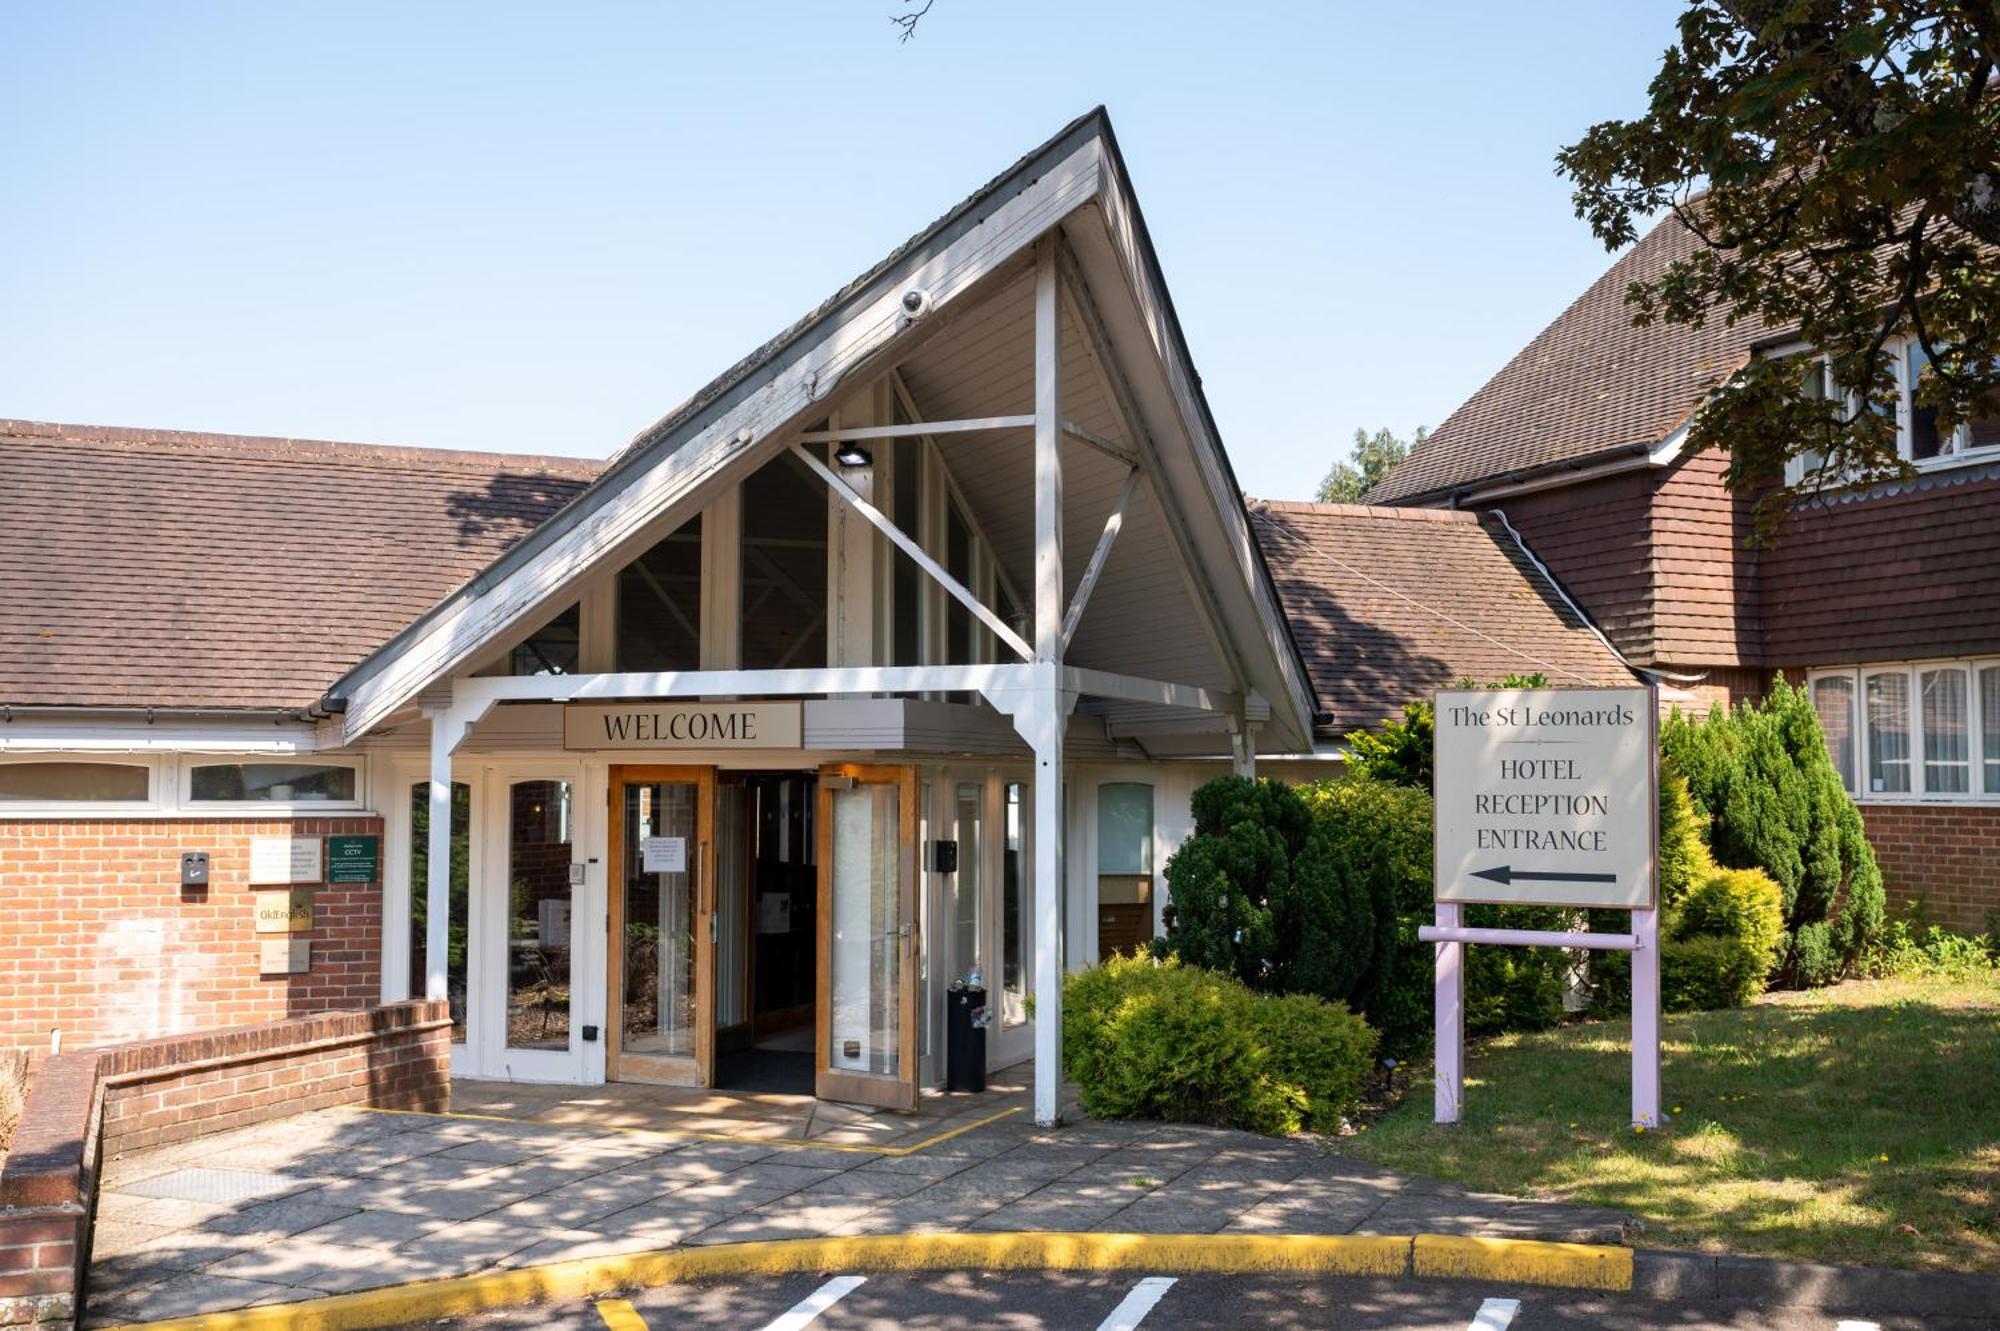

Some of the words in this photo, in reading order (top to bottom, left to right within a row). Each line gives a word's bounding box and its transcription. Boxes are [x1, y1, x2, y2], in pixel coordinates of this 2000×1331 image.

[603, 712, 757, 741] WELCOME
[1448, 705, 1491, 727] The
[1496, 706, 1518, 727] St
[1525, 704, 1634, 727] Leonards
[1500, 759, 1582, 780] HOTEL
[1474, 794, 1608, 816] RECEPTION
[1477, 828, 1608, 852] ENTRANCE
